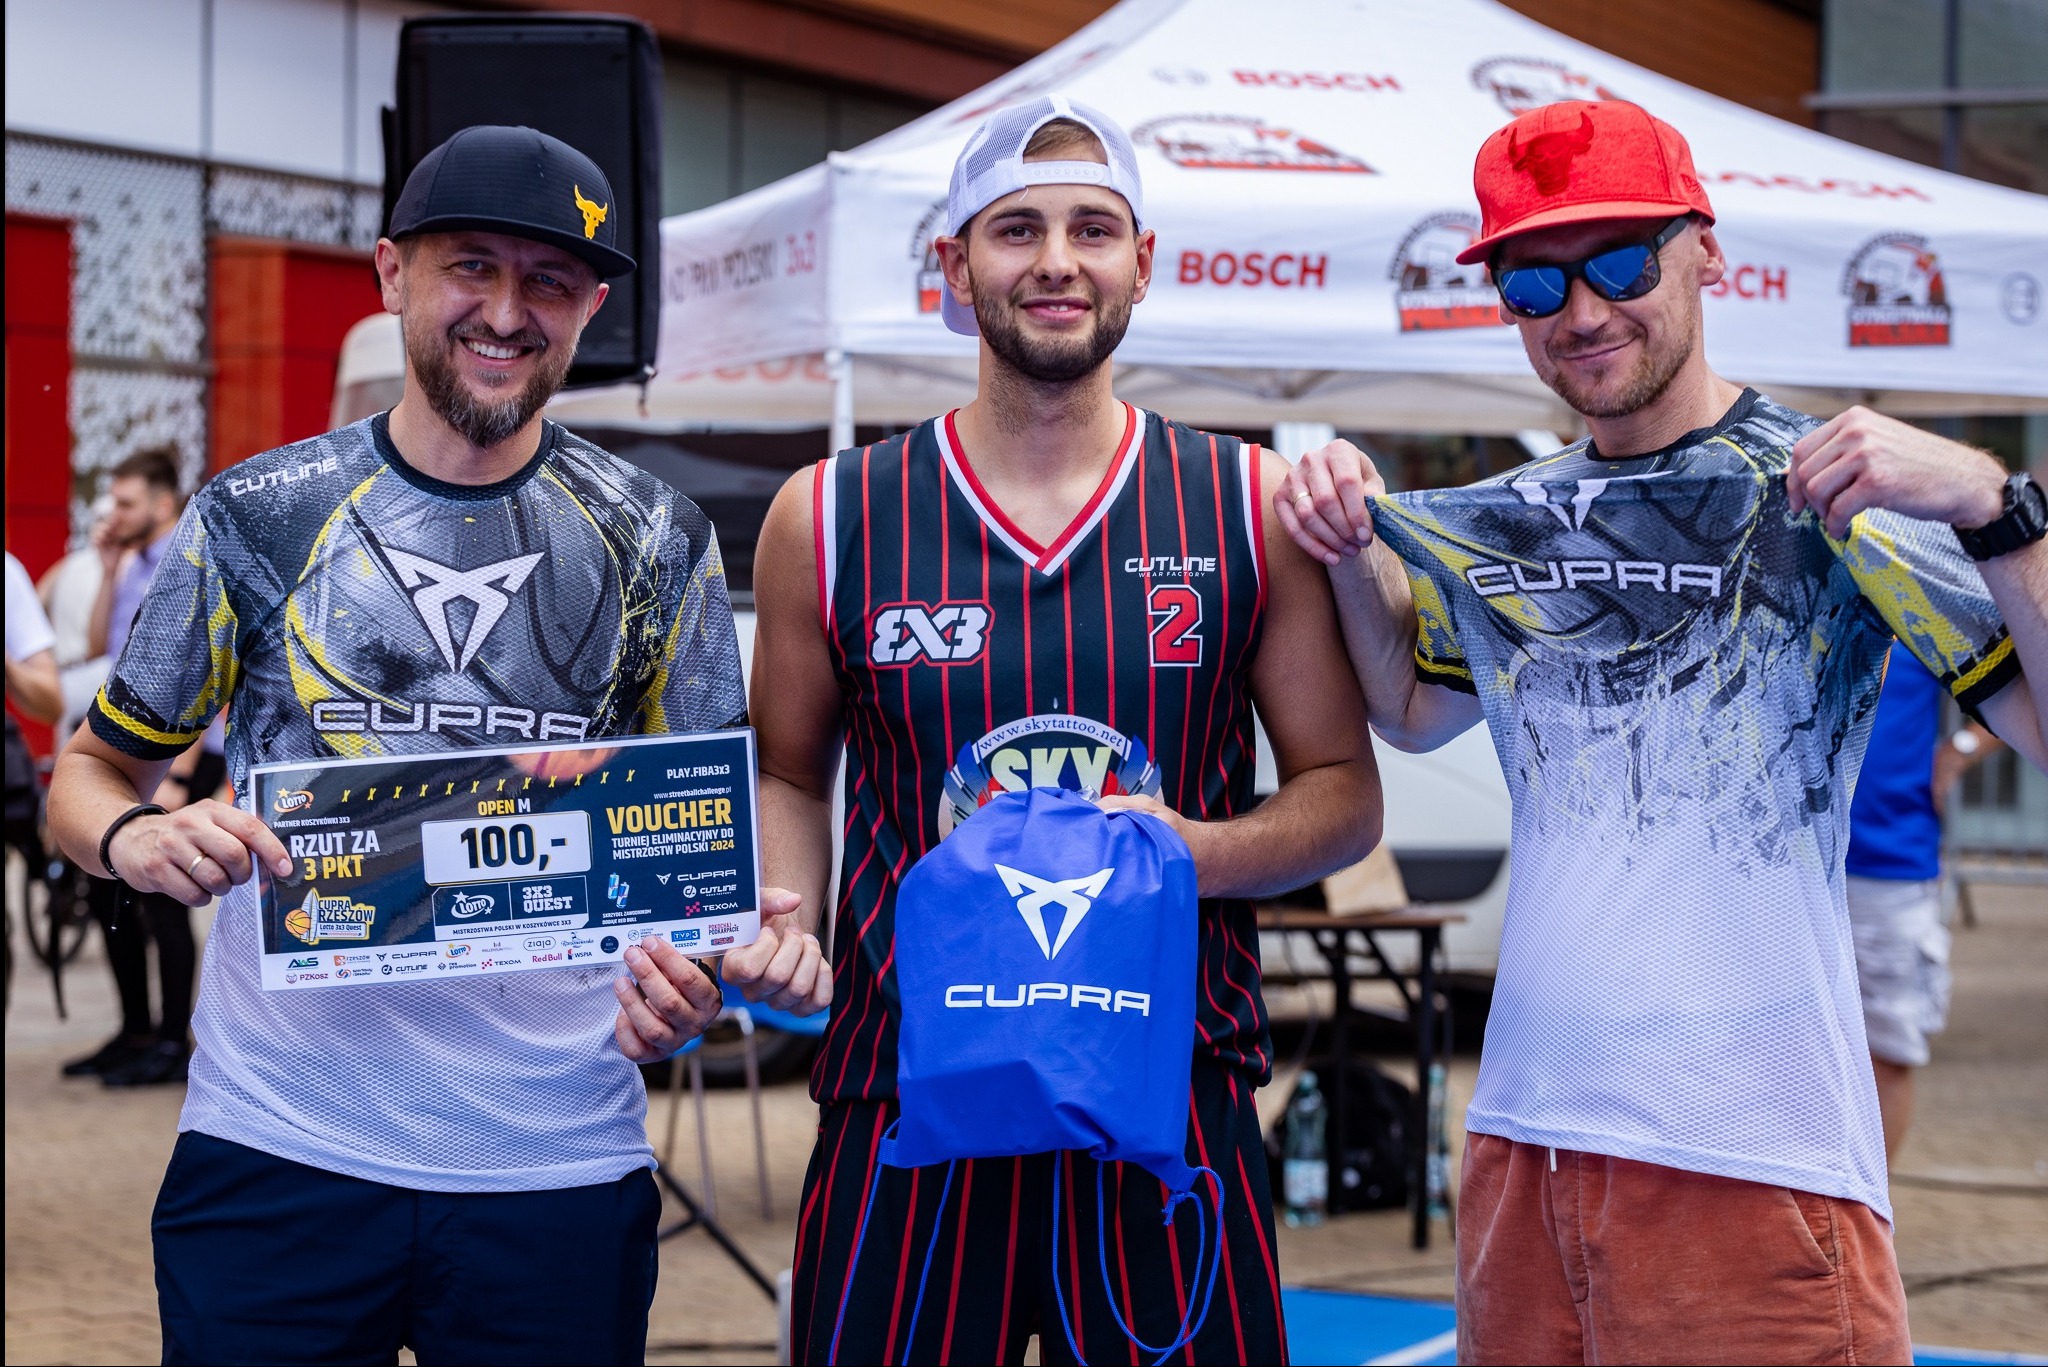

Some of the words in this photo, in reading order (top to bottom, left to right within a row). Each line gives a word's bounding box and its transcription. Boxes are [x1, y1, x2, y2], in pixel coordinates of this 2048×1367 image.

[1232, 70, 1403, 92] BOSCH
[1179, 251, 1327, 288] BOSCH
[231, 457, 337, 496] CUTLINE
[1125, 557, 1216, 573] CUTLINE
[1466, 561, 1722, 597] CUPRA
[1147, 584, 1203, 667] 2
[313, 702, 591, 742] CUPRA
[980, 718, 1124, 750] www.skytattoo.net
[667, 764, 730, 779] PLAY.FIBA3x3
[991, 747, 1113, 797] SKY
[281, 794, 307, 809] LOTTO
[653, 786, 732, 800] www.streetballchallenge.pl
[477, 799, 515, 816] OPEN
[517, 798, 531, 813] M
[273, 819, 301, 828] PARTNER
[301, 817, 339, 827] KOSZYKÓWKI
[606, 798, 733, 835] VOUCHER
[290, 832, 346, 858] RZUT
[350, 830, 380, 854] ZA
[611, 836, 650, 848] TURNIEJ
[652, 829, 719, 846] ELIMINACYJNY
[720, 828, 734, 839] DO
[460, 823, 568, 872] 100,-
[612, 845, 673, 860] MISTRZOSTW
[676, 841, 709, 855] POLSKI
[710, 840, 735, 851] 2024
[303, 858, 317, 881] 3
[322, 855, 364, 879] PKT
[677, 869, 737, 881] CUPRA
[522, 885, 553, 900] 3X3
[700, 884, 737, 894] CUTLINE
[318, 900, 351, 910] CUPRA
[459, 899, 487, 914] LOTTO
[523, 896, 573, 914] QUEST
[703, 902, 739, 912] TEXOM
[319, 907, 373, 922] RZESZÓW
[453, 926, 493, 935] MISTRZOSTWA
[522, 920, 560, 929] KOSZYKÓWCE
[450, 946, 467, 956] LOTTO
[527, 940, 551, 949] ziaja
[392, 951, 437, 959] CUPRA
[396, 964, 428, 972] CUTLINE
[945, 982, 1151, 1017] CUPRA
